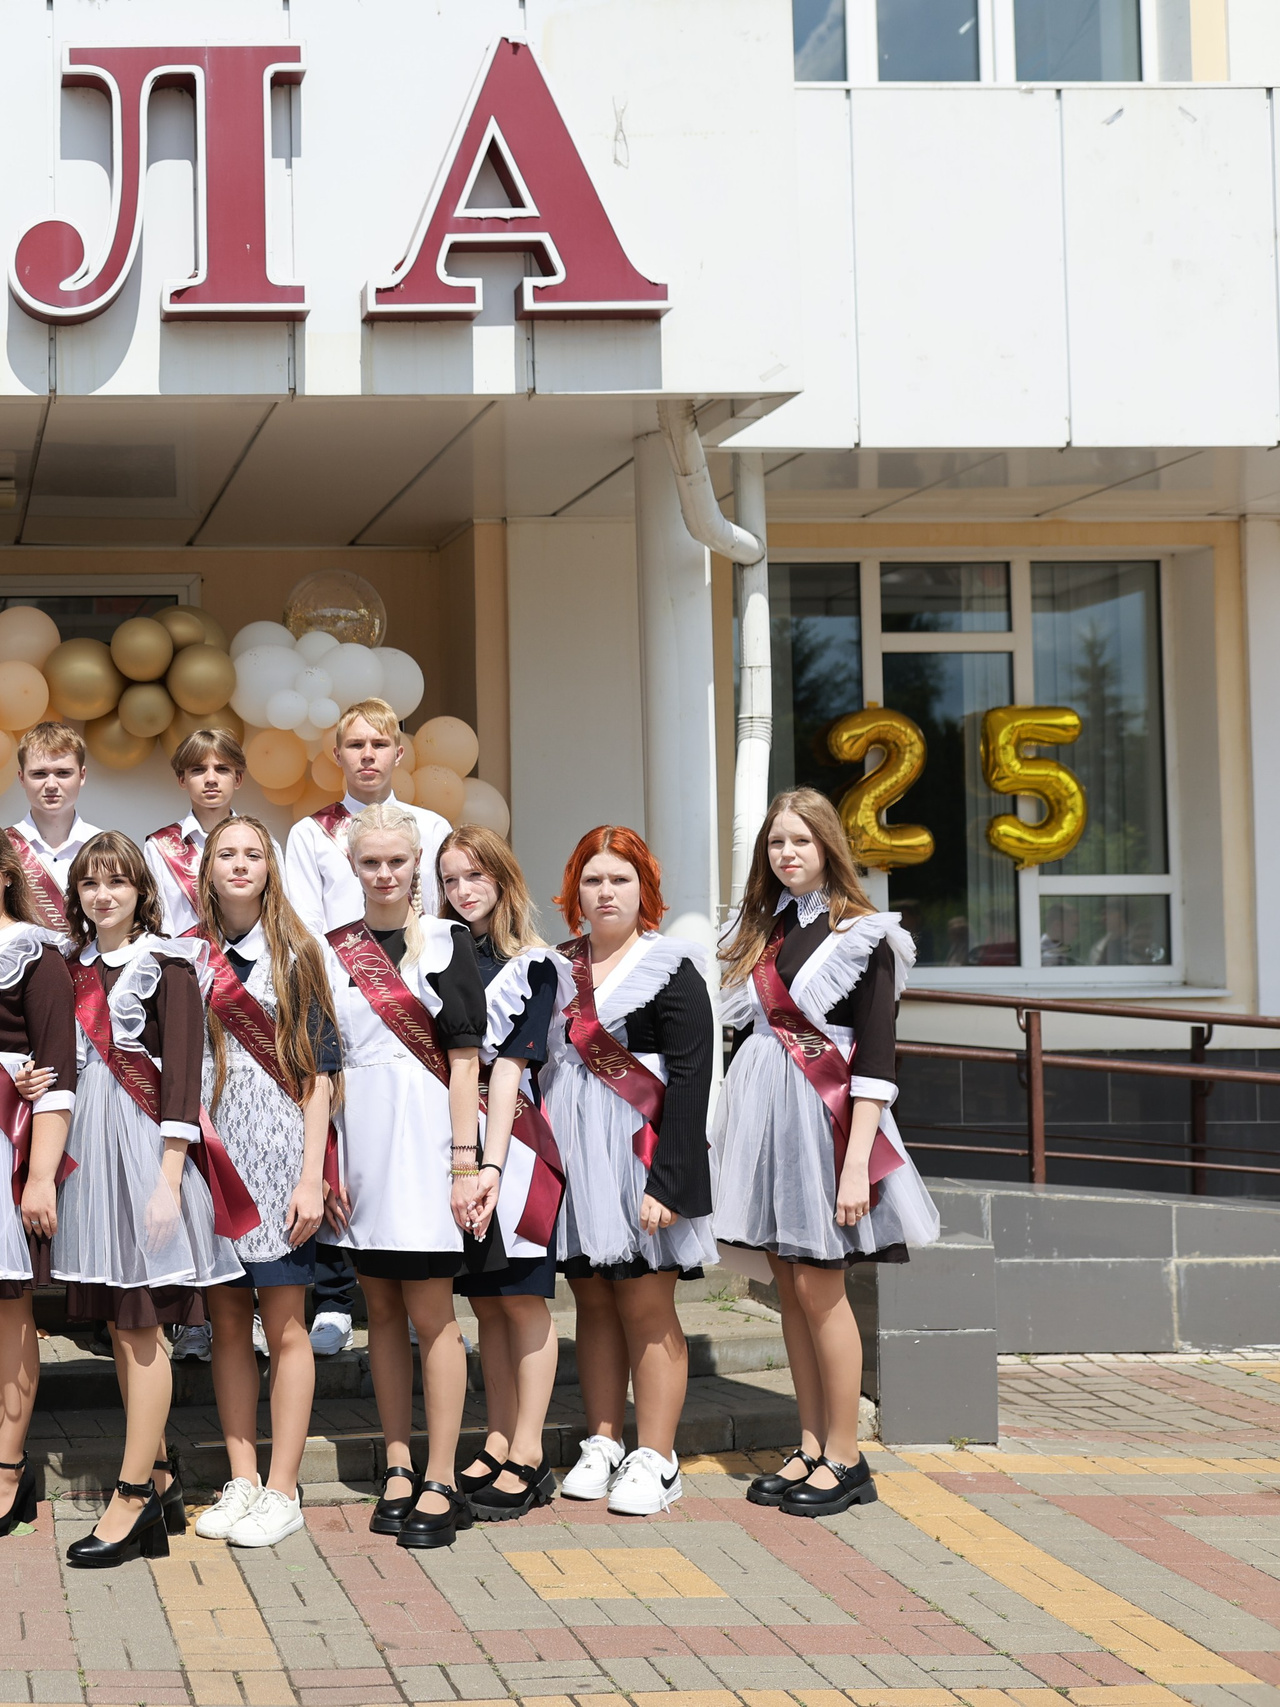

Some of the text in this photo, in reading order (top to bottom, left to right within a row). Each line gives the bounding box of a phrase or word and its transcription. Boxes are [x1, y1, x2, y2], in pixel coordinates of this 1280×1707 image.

[826, 701, 1088, 871] 25
[352, 952, 435, 1050] Выпускница
[592, 1050, 636, 1080] 2025
[790, 1028, 834, 1058] 2025
